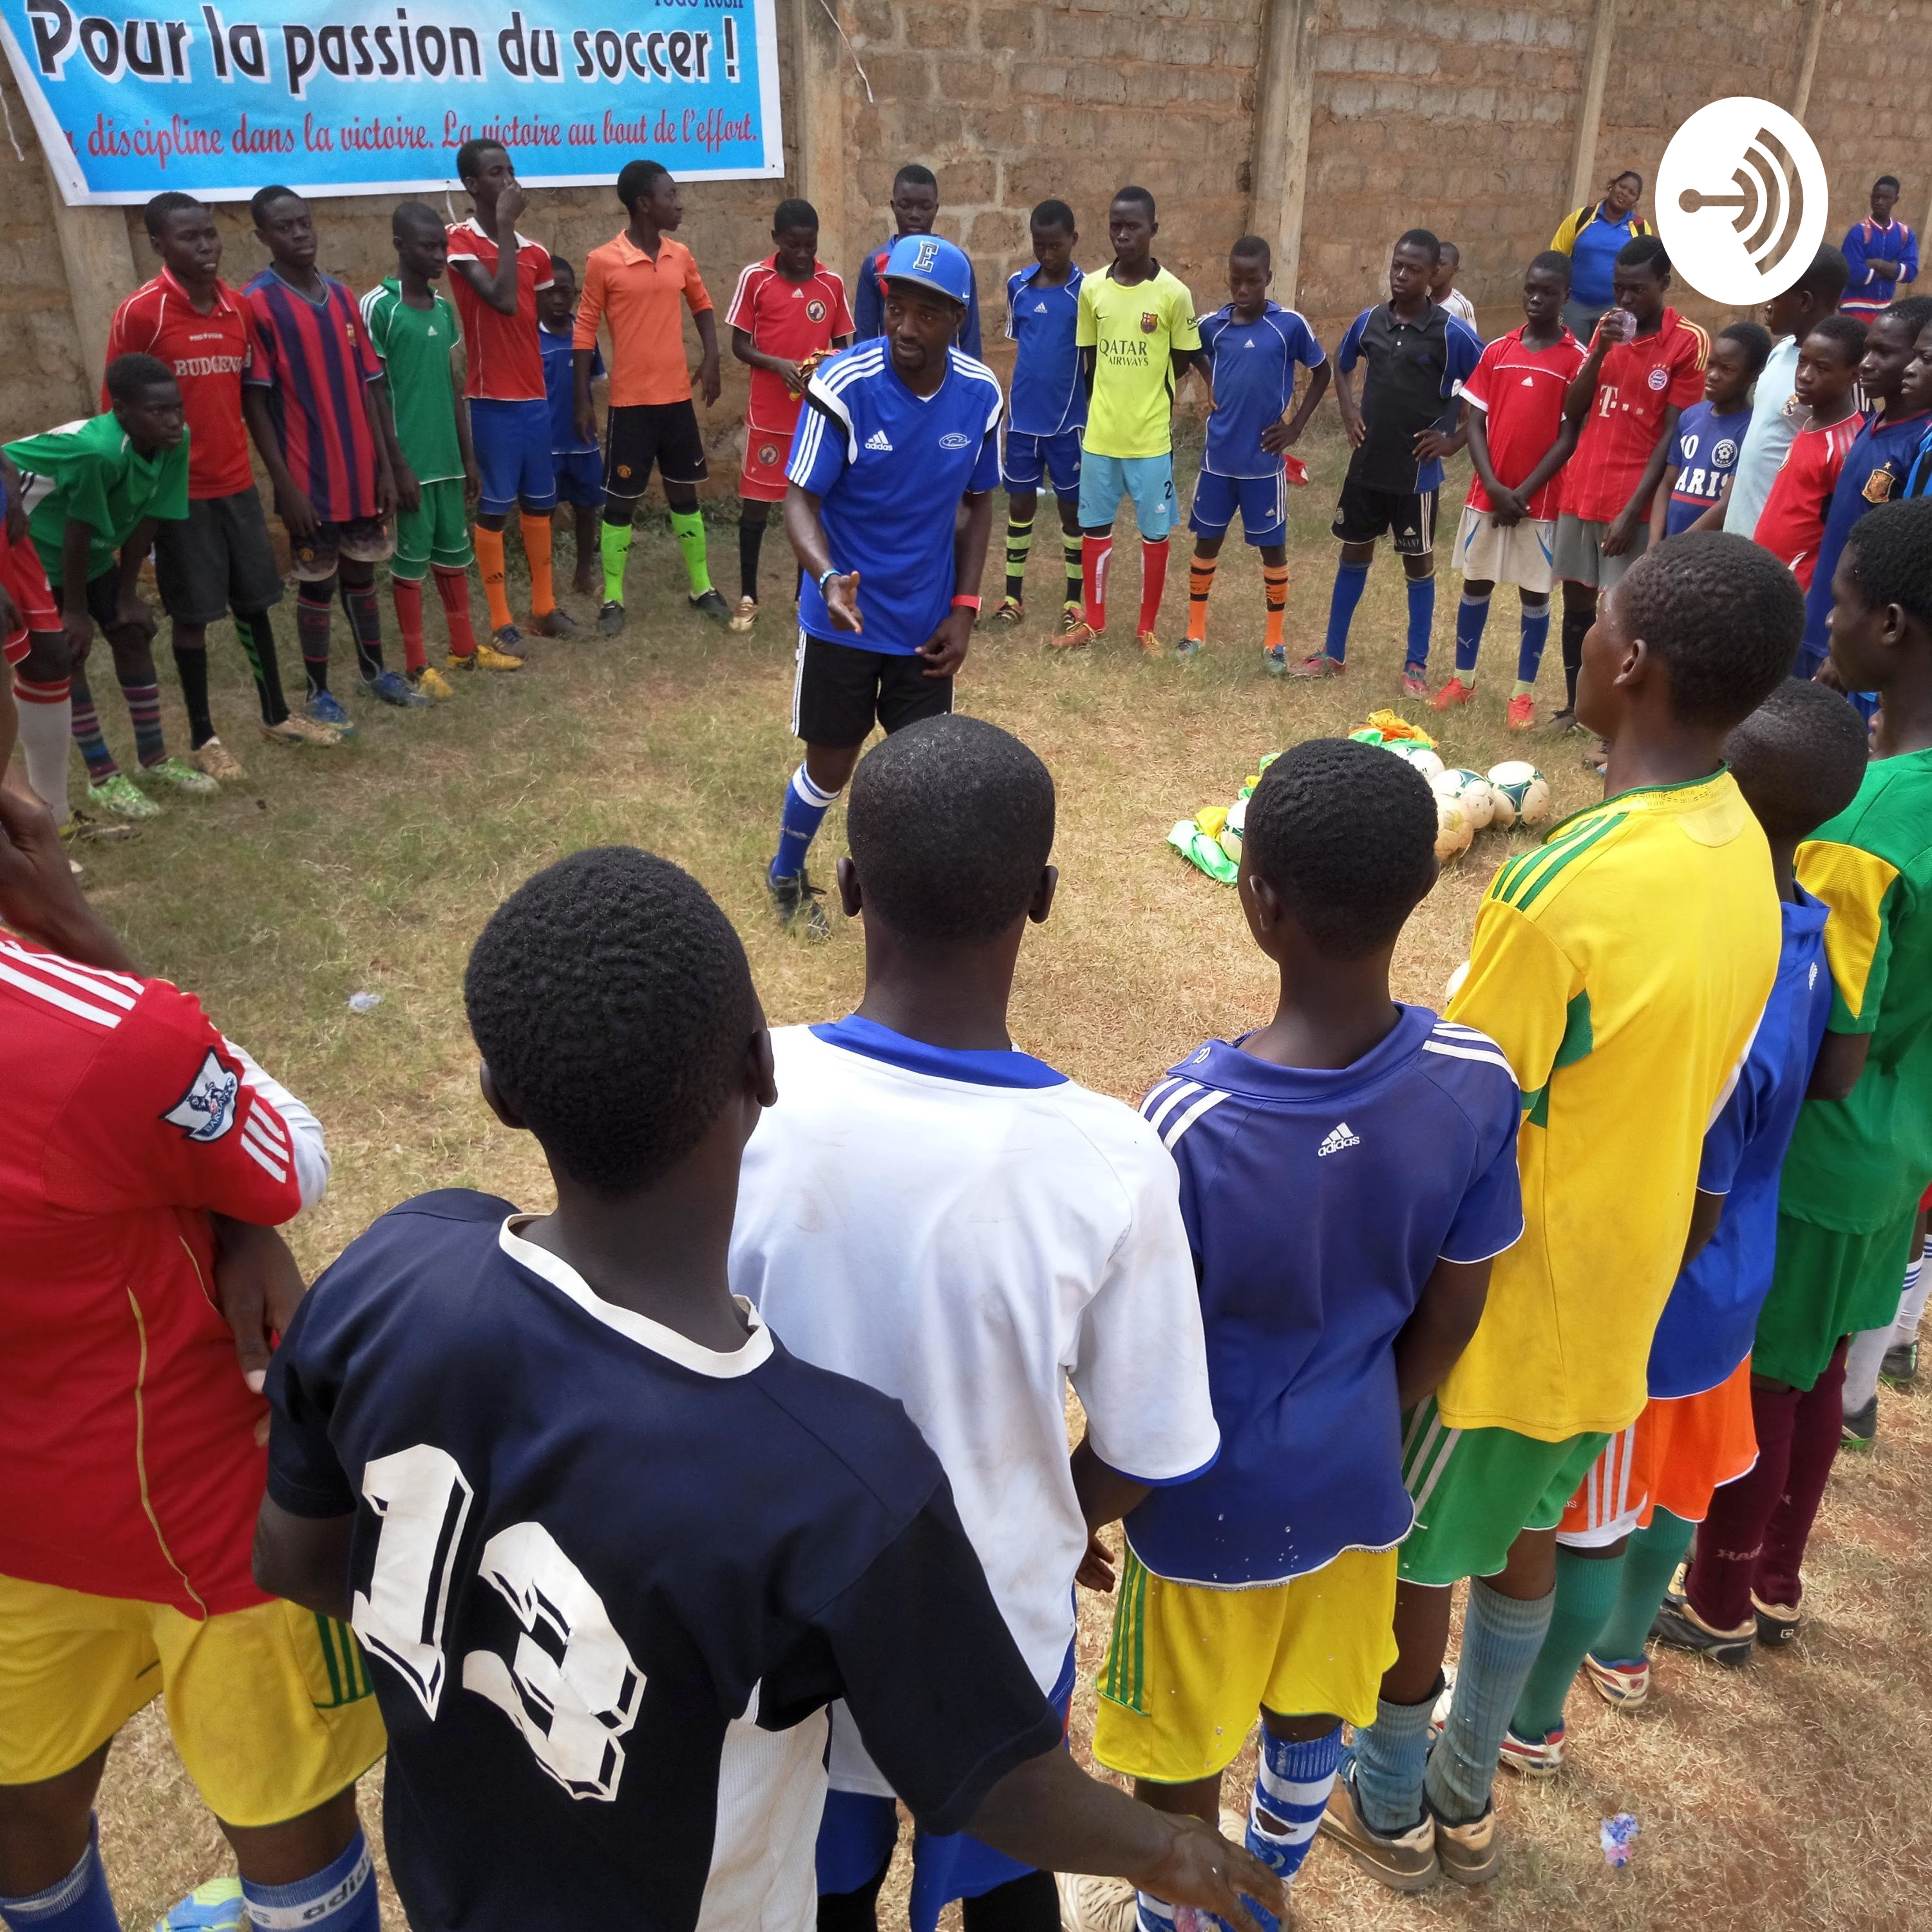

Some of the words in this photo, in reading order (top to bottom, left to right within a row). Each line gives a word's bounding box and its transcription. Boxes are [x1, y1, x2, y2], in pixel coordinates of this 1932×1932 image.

[26, 0, 187, 77] Pour
[202, 5, 265, 77] la
[282, 8, 482, 94] passion
[498, 12, 560, 77] du
[574, 30, 709, 78] soccer
[88, 113, 224, 169] discipline
[231, 113, 294, 154] dans
[304, 112, 334, 152] la
[341, 115, 434, 151] victoire.
[442, 110, 471, 147] La
[482, 115, 562, 147] victoire
[568, 123, 596, 146] au
[603, 109, 648, 145] bout
[654, 108, 677, 143] de
[913, 240, 939, 273] E
[1099, 339, 1148, 357] QATAR
[174, 355, 243, 376] BUDGEN
[1108, 356, 1149, 366] AIRWAYS
[865, 442, 893, 451] adidas
[1680, 434, 1699, 459] 10
[1164, 480, 1172, 500] 2
[1674, 466, 1728, 497] ARI
[1318, 1136, 1360, 1157] adidas
[352, 1443, 647, 1801] 13
